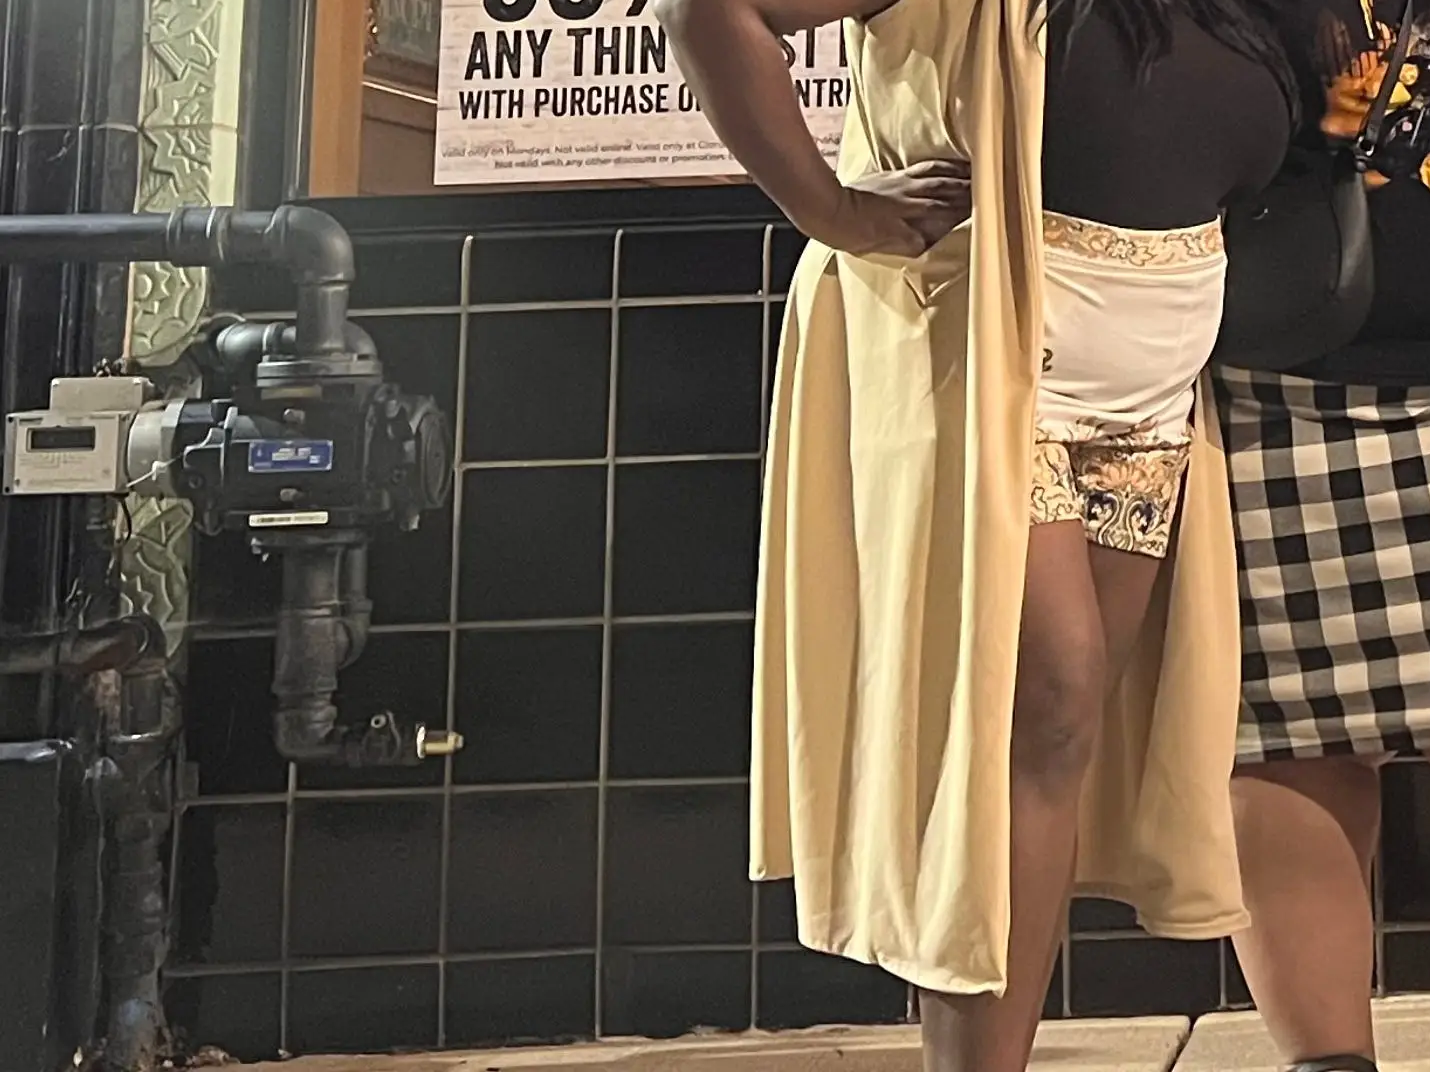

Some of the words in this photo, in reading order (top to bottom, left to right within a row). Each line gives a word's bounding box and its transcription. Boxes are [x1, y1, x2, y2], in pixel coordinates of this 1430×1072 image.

[464, 29, 552, 80] ANY
[567, 25, 667, 76] THIN
[459, 89, 524, 120] WITH
[535, 84, 669, 118] PURCHASE
[678, 82, 701, 112] O
[555, 145, 572, 154] Not
